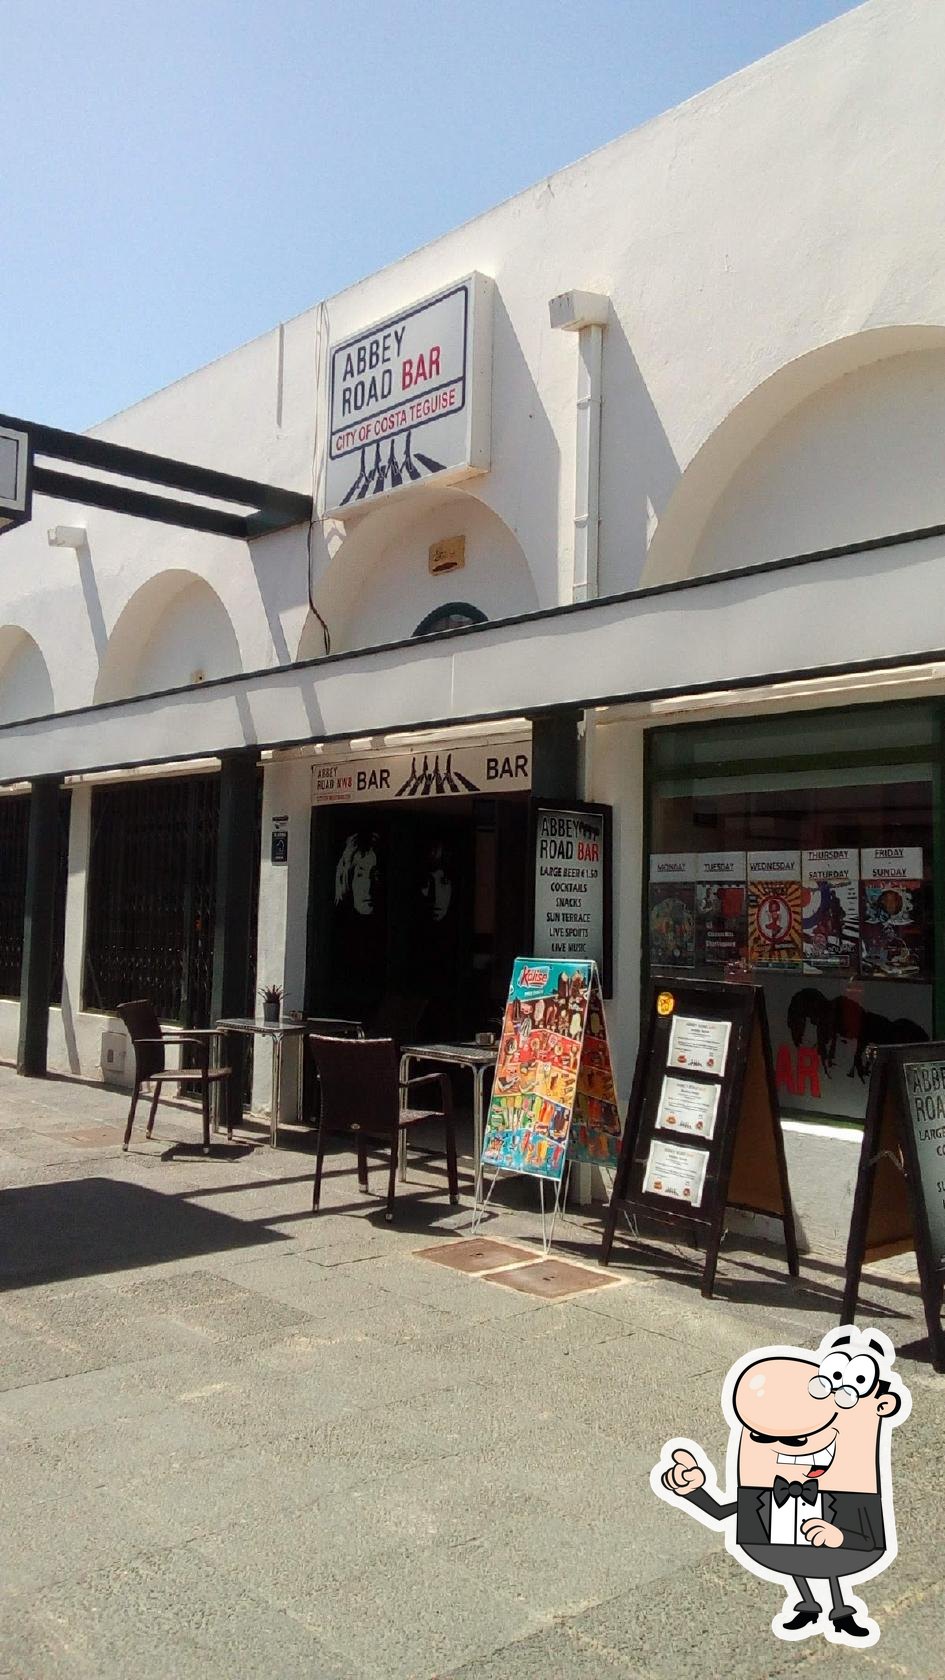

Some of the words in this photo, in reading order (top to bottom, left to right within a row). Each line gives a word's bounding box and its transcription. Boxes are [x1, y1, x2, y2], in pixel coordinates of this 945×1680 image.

[342, 325, 406, 382] ABBEY
[342, 368, 393, 417] ROAD
[401, 345, 441, 391] BAR
[335, 430, 356, 451] CITY
[358, 423, 372, 443] OF
[373, 409, 407, 437] COSTA
[409, 388, 456, 423] TEGUISE
[317, 766, 338, 779] ABBEY
[486, 754, 529, 780] BAR
[317, 778, 335, 790] ROAD
[356, 768, 391, 791] BAR
[541, 817, 579, 838] ABBEY
[540, 839, 574, 860] ROAD
[577, 841, 600, 862] BAR
[808, 850, 849, 860] THURSDAY
[874, 848, 904, 859] FRIDAY
[540, 866, 562, 877] LARGE
[563, 867, 580, 878] BEER
[657, 863, 686, 871] MONDAY
[703, 862, 735, 872] TUESDAY
[750, 861, 796, 872] WEDNESDAY
[872, 867, 907, 877] SUNDAY
[808, 870, 849, 880] SATURDAY
[550, 882, 588, 893] COCKTAILS
[555, 897, 582, 908] SNACKS
[546, 911, 561, 922] SUN
[561, 912, 591, 923] TERRACE
[549, 927, 564, 937] LIVE
[564, 927, 589, 938] SPORTS
[551, 942, 567, 952] LIVE
[567, 942, 587, 952] MUSIC
[775, 1042, 821, 1098] AR
